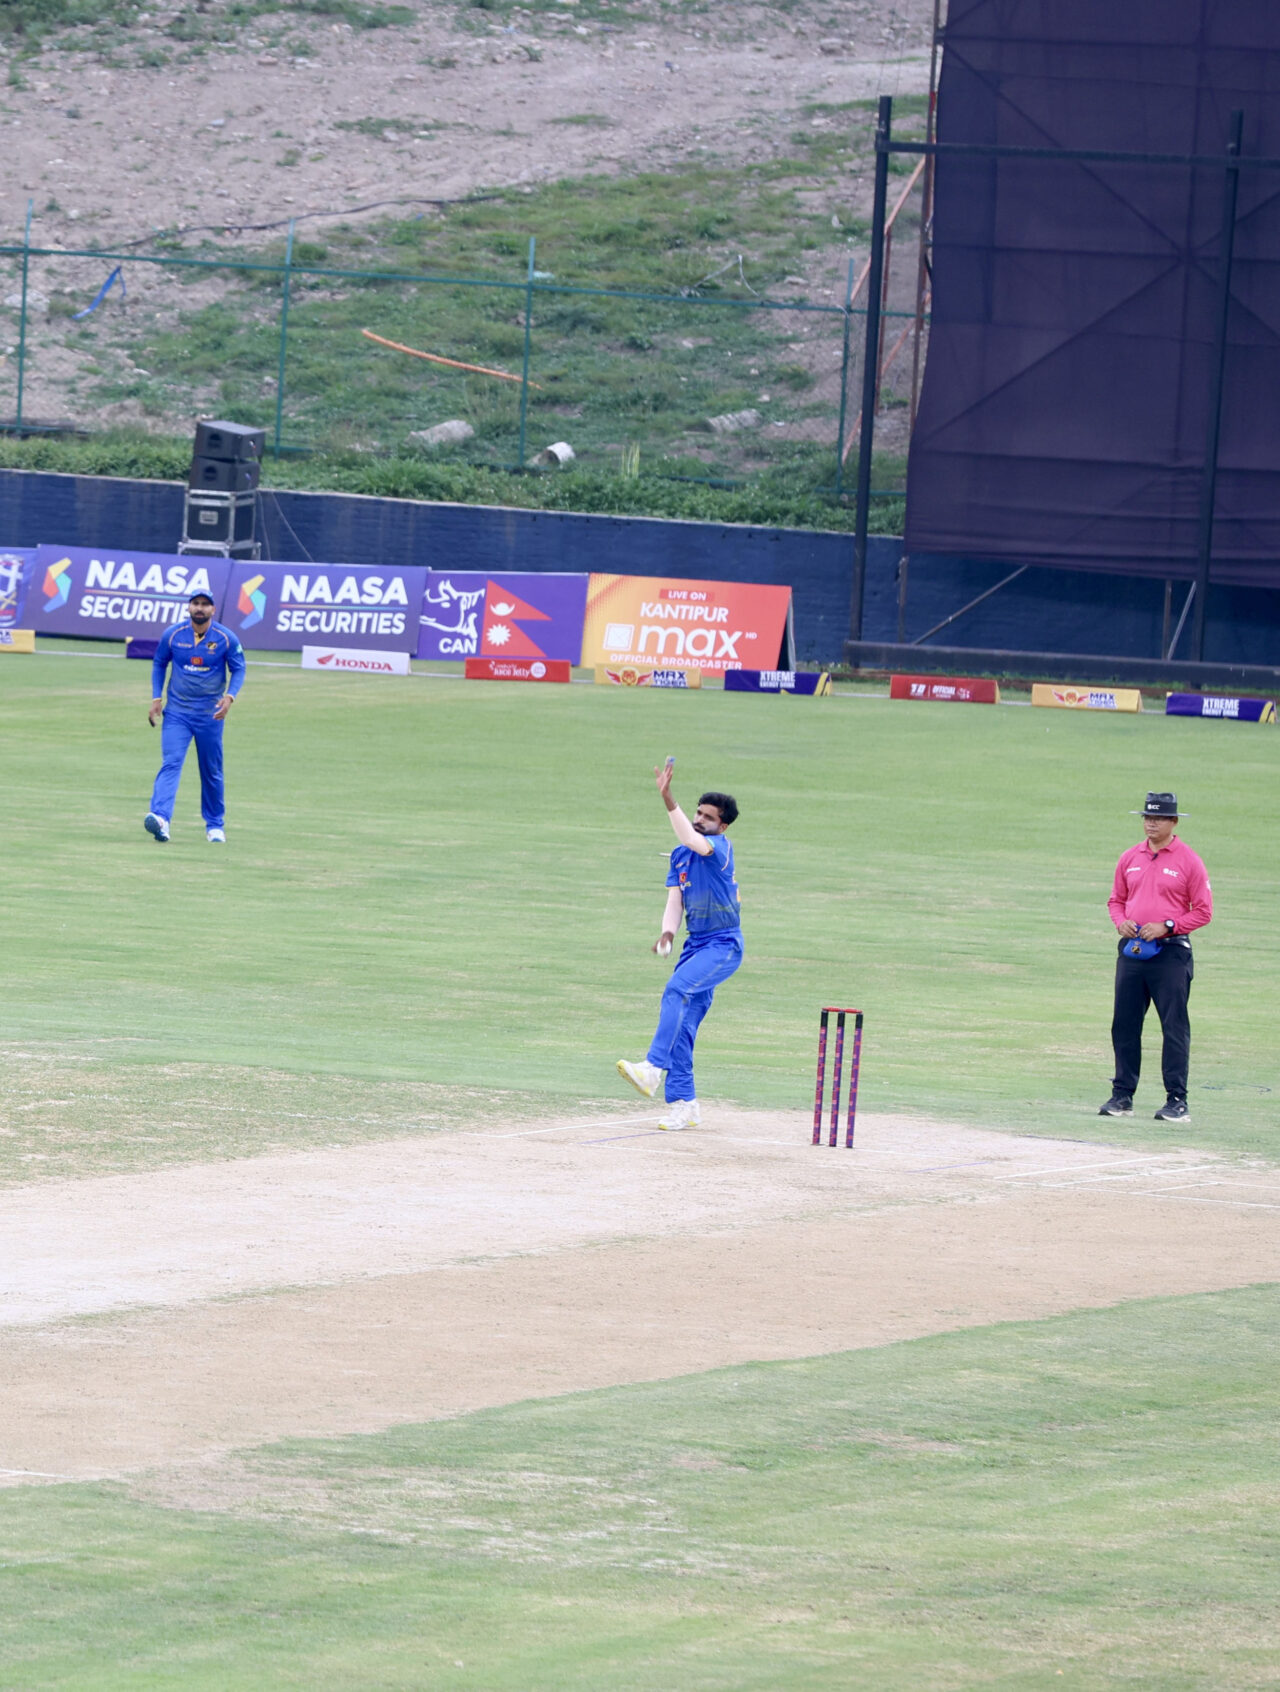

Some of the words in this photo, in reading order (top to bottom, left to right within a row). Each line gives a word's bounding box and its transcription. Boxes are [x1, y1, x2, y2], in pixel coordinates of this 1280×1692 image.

[85, 559, 211, 595] NAASA
[280, 574, 409, 605] NAASA
[668, 590, 688, 600] LIVE
[690, 591, 707, 601] ON
[78, 595, 191, 623] SECURITIE
[640, 602, 729, 623] KANTIPUR
[276, 610, 407, 634] SECURITIES
[438, 637, 478, 654] CAN
[637, 624, 743, 659] max
[335, 658, 394, 671] HONDA
[610, 653, 658, 666] OFFICIAL
[661, 657, 743, 671] BROADCASTER
[759, 670, 796, 682] XTREME
[1202, 697, 1240, 710] XTREME
